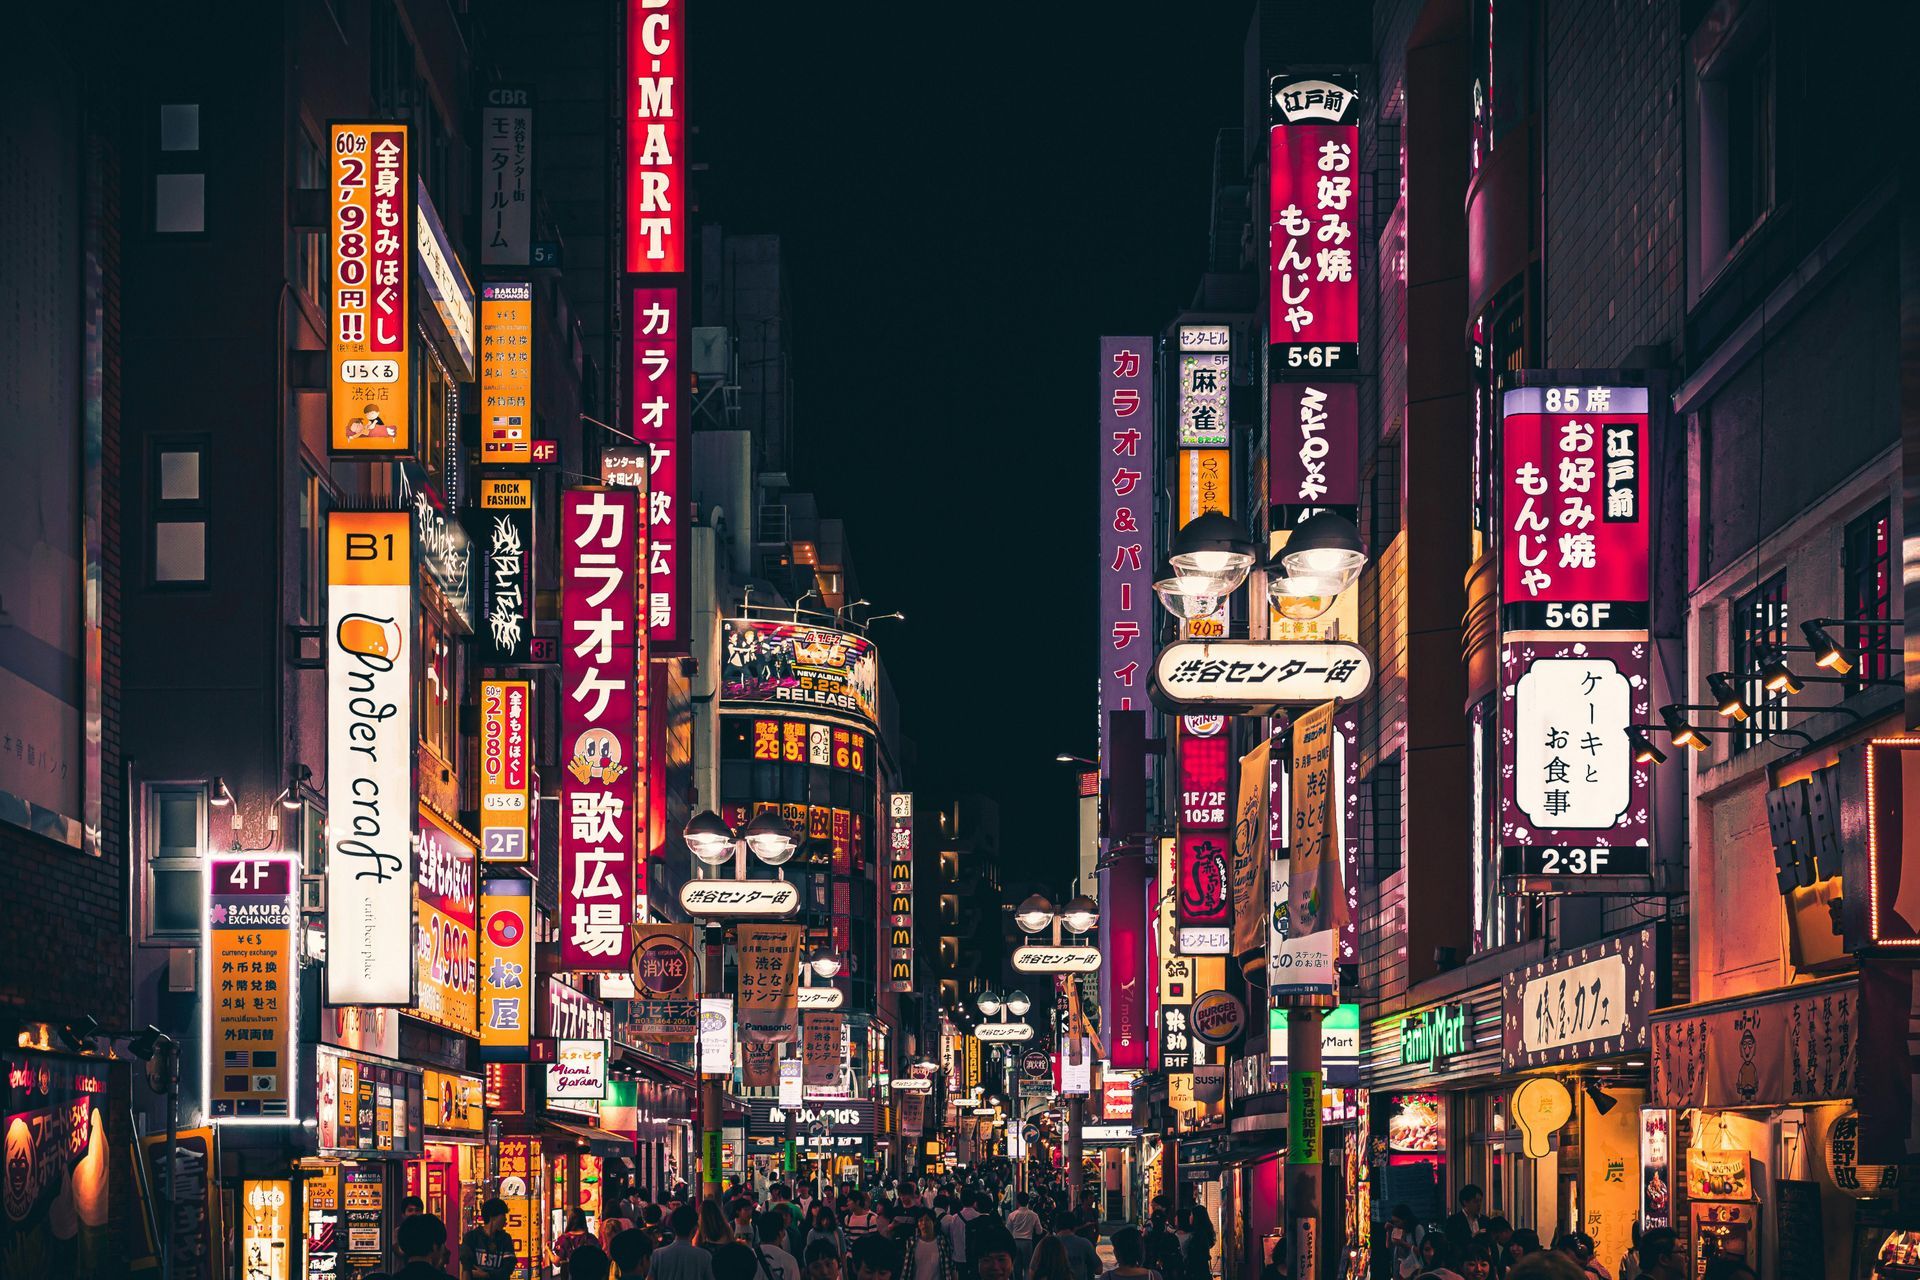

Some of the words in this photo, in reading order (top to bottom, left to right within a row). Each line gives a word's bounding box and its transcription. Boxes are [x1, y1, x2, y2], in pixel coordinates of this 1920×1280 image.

[489, 89, 527, 105] CBR
[1284, 88, 1344, 113] 江戸前
[638, 0, 674, 259] C-MART
[336, 133, 366, 154] 60分
[514, 117, 526, 202] 渋谷センター街
[489, 117, 510, 248] モニタールーム
[1316, 140, 1352, 283] お好み焼
[374, 138, 400, 345] 全身もみほぐし
[535, 249, 553, 262] 5F
[1278, 203, 1314, 333] もんじゃ
[1181, 331, 1228, 347] センタービル
[1214, 356, 1229, 366] 5F
[346, 364, 394, 378] りらくる
[352, 387, 389, 401] 渋谷店
[640, 303, 671, 475] カラオケ
[1192, 368, 1217, 431] 麻雀
[1545, 386, 1611, 413] 85席
[533, 446, 555, 460] 4F
[605, 456, 645, 468] センター街
[1606, 428, 1634, 518] 江戸前
[493, 483, 519, 494] ROCK
[1558, 420, 1596, 569] お好み焼
[487, 496, 527, 506] FASHION
[1514, 461, 1552, 597] もんじゃ
[346, 532, 394, 561] B1
[573, 493, 625, 722] カラオケ
[534, 641, 554, 659] 3F
[797, 670, 816, 679] NEW
[817, 673, 843, 683] ALBUM
[1168, 658, 1361, 683] 渋谷センター街
[776, 687, 856, 710] RELEASE
[1193, 715, 1218, 727] KING
[1581, 671, 1603, 783] ケーキと
[509, 690, 522, 786] 全身もみほぐし
[1543, 726, 1571, 817] お食事
[1307, 769, 1328, 797] 渋谷
[487, 797, 522, 808] りらくる
[1183, 792, 1226, 806] 1F/2F
[783, 806, 805, 819] 30分
[1185, 809, 1225, 823] 105席
[336, 777, 402, 885] craft
[490, 834, 519, 853] 2F
[230, 861, 270, 889] 4F
[418, 828, 475, 913] 全身もみほぐし
[571, 790, 625, 957] 歌広場
[686, 890, 792, 904] 渋谷センター街
[229, 904, 290, 915] SAKURA
[229, 916, 282, 925] EXCHANGE
[1181, 933, 1228, 947] センタービル
[644, 959, 683, 977] 消火栓
[756, 957, 783, 971] 渋谷
[1018, 954, 1098, 964] 渋谷センター街
[743, 973, 794, 985] おとなり
[488, 957, 522, 1029] 松屋
[742, 988, 794, 1002] サンデー
[646, 1001, 697, 1018] セキネ
[1121, 976, 1136, 1047] Y!mobile
[1199, 1003, 1235, 1020] BURGER
[1536, 977, 1610, 1045] 椿屋カフェ
[745, 1022, 792, 1032] Panasonic
[1200, 1011, 1237, 1032] KING
[1401, 1003, 1464, 1072] FamilyMart
[536, 1042, 552, 1059] 1F
[549, 1063, 590, 1075] Miami
[1165, 1057, 1188, 1068] B1F
[75, 1073, 107, 1093] Kitchen
[1195, 1075, 1224, 1085] SUSHI
